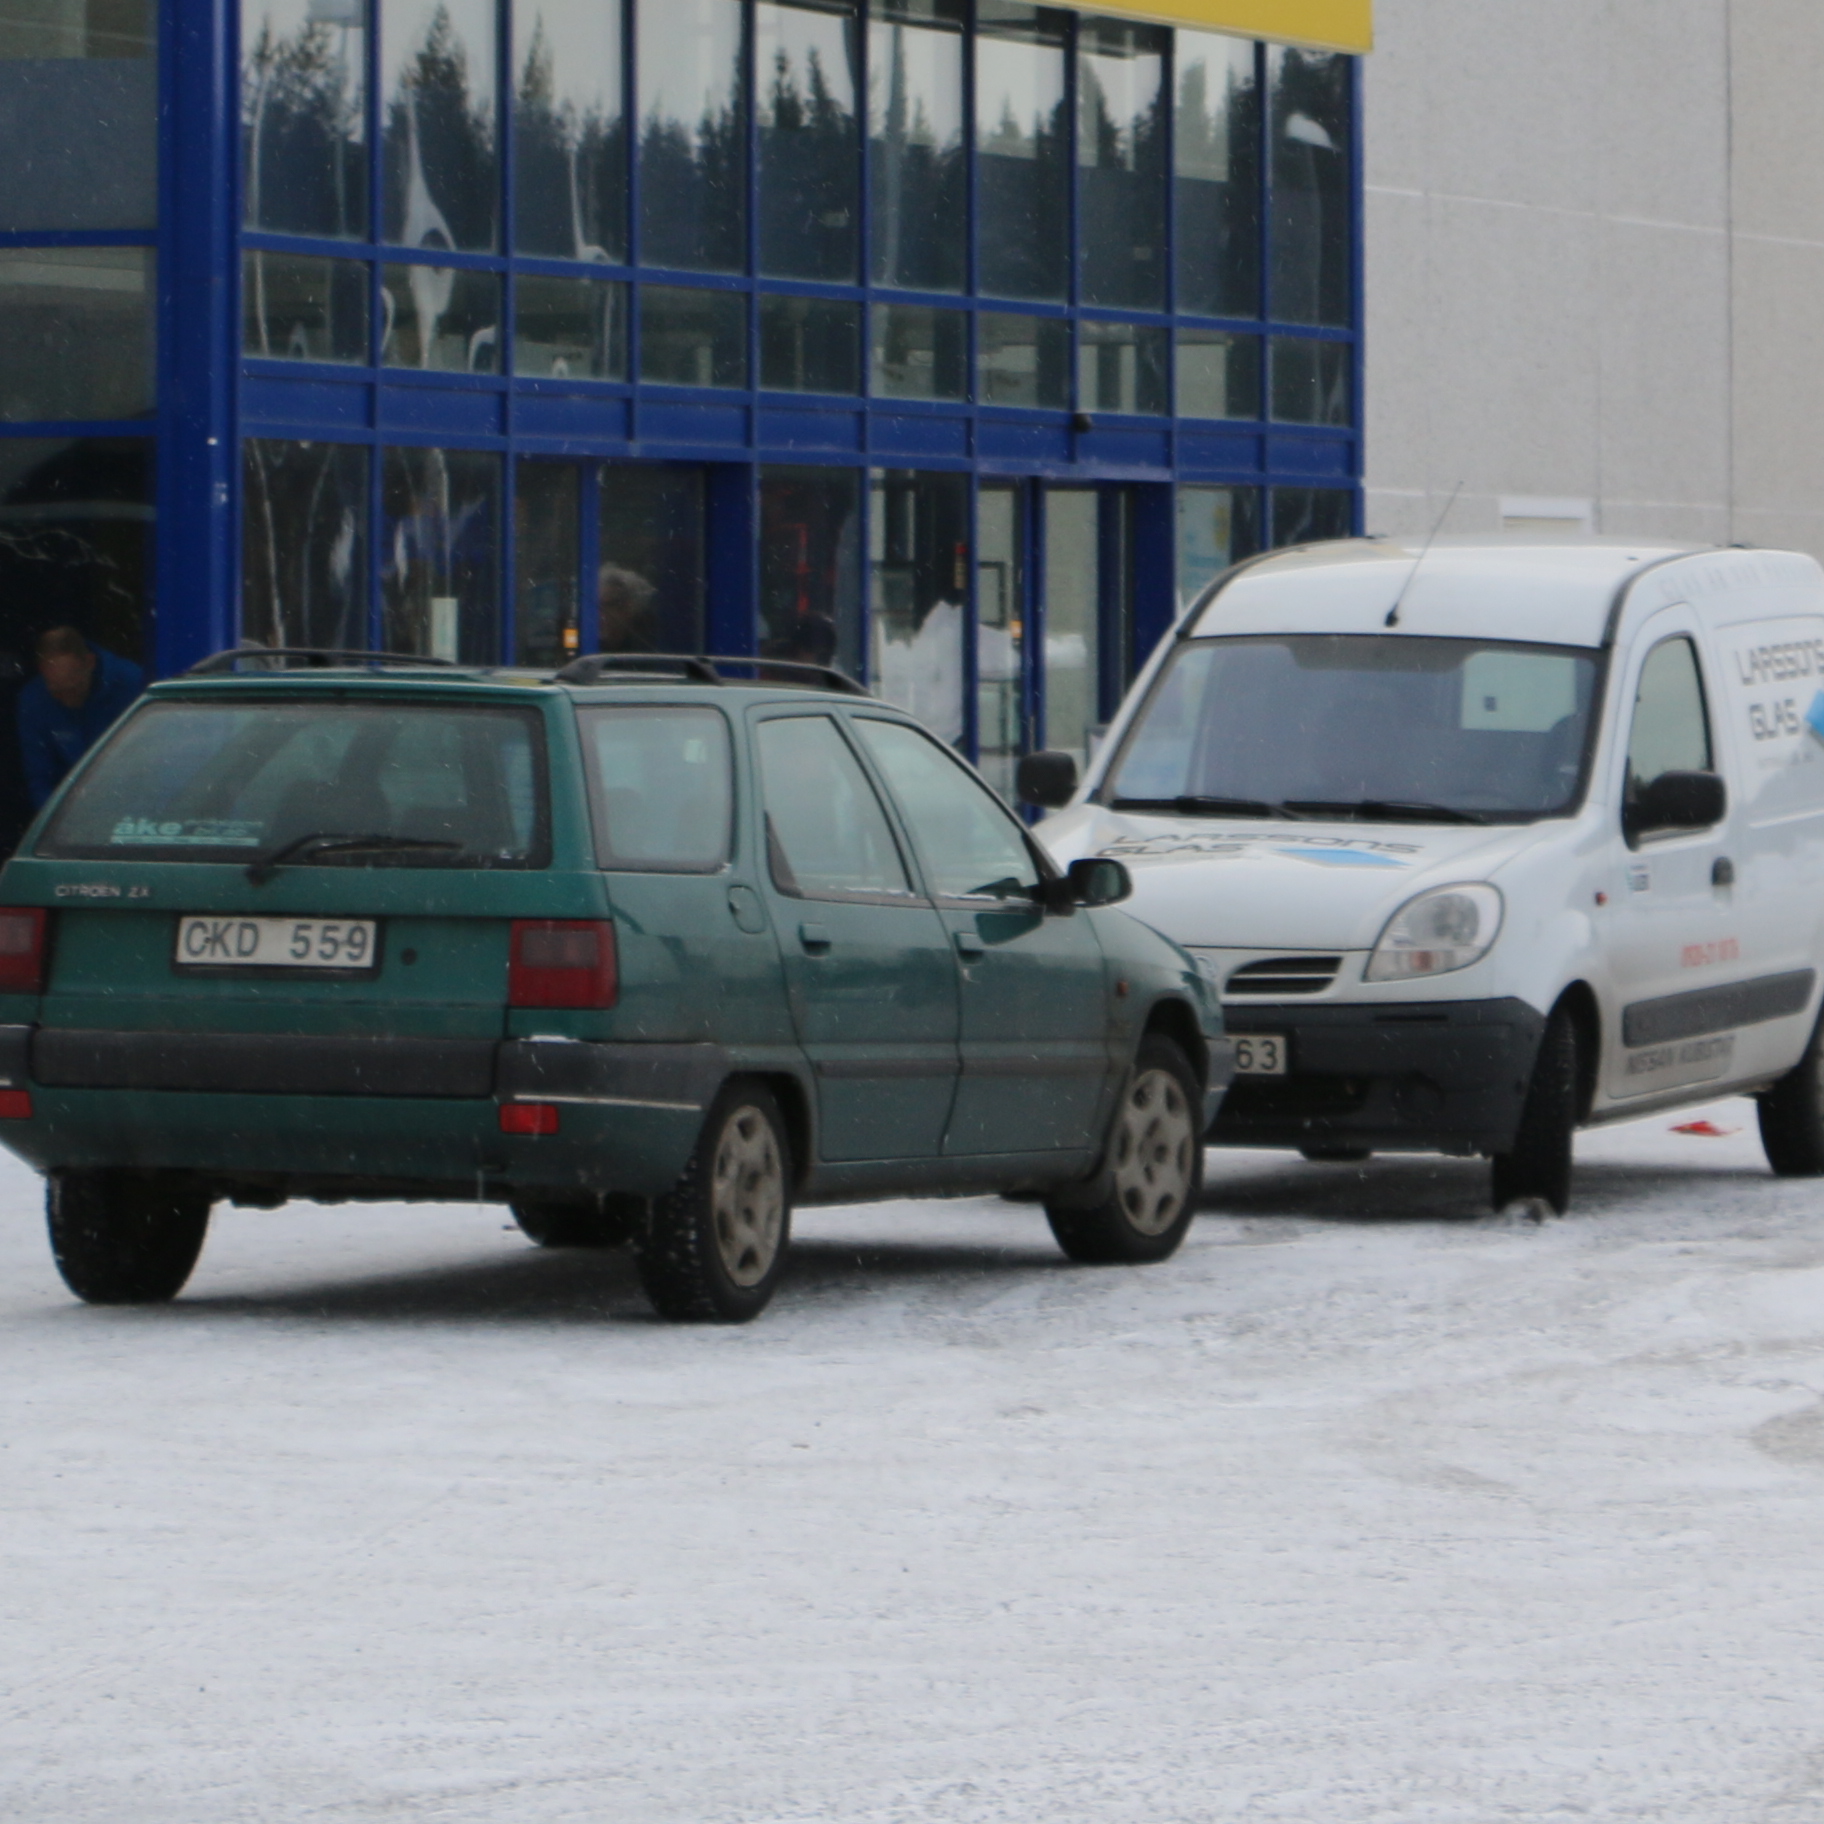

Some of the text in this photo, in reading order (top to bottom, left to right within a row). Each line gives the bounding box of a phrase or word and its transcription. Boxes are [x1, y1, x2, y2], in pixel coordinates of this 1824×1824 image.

[1748, 698, 1800, 742] GLAS
[1113, 832, 1425, 854] LARSSONS
[289, 923, 369, 962] 559
